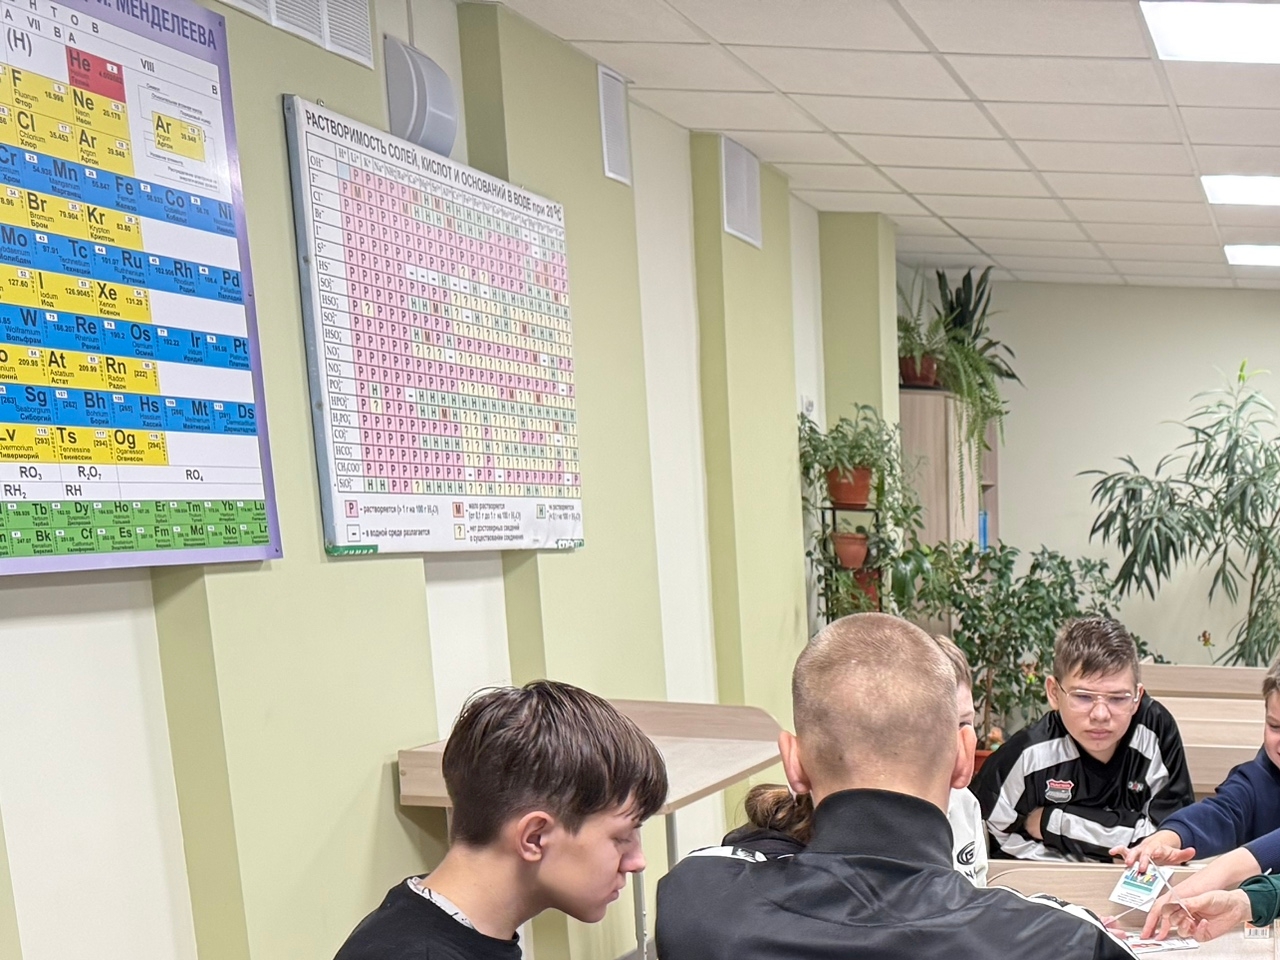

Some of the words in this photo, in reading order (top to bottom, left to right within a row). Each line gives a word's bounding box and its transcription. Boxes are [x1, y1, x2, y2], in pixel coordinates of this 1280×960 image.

[27, 16, 41, 31] VII
[50, 6, 58, 18] Т
[70, 14, 79, 26] О
[91, 22, 99, 34] В
[116, 0, 217, 50] МЕНДЕЛЕЕВА
[7, 27, 32, 57] (H)
[69, 49, 91, 72] He
[140, 58, 155, 73] VIII
[73, 88, 95, 111] Ne
[17, 110, 36, 132] Cl
[156, 115, 172, 134] Ar
[79, 129, 97, 149] Ar
[53, 159, 78, 181] Mn
[305, 109, 387, 155] РАСТВОРИМОСТЬ
[388, 143, 420, 170] СОЛЕЙ,
[420, 155, 452, 180] КИСЛОТ
[454, 168, 461, 184] И
[461, 171, 506, 201] ОСНОВАНИЙ
[507, 189, 513, 203] В
[513, 192, 531, 211] ВОДЕ
[532, 203, 545, 217] при
[115, 176, 134, 196] Fe
[27, 191, 47, 213] Br
[165, 189, 185, 209] Co
[86, 205, 105, 226] Kr
[219, 202, 233, 221] Ni
[1, 225, 28, 247] Mo
[68, 239, 88, 259] Tc
[121, 250, 142, 270] Ru
[173, 260, 193, 280] Rh
[222, 270, 240, 288] Pd
[97, 281, 117, 301] Xe
[20, 308, 37, 327] W
[75, 315, 97, 335] Re
[130, 323, 151, 342] Os
[233, 338, 248, 354] Pt
[48, 350, 67, 369] At
[105, 356, 127, 375] Rn
[24, 386, 48, 407] Sg
[84, 392, 106, 409] Bh
[140, 396, 160, 413] Hs
[192, 400, 209, 417] Mt
[238, 404, 255, 419] Ds
[56, 427, 77, 444] Ts
[114, 429, 136, 449] Og
[65, 484, 82, 496] RH
[32, 503, 47, 516] Tb
[74, 502, 89, 516] Dy
[114, 501, 129, 513] Ho
[155, 501, 166, 512] Er
[186, 501, 201, 512] Tm
[222, 500, 234, 511] Yb
[254, 500, 265, 511] Lu
[349, 503, 354, 514] Р
[36, 530, 52, 542] Bk
[81, 528, 93, 540] Cf
[119, 527, 133, 538] Es
[154, 526, 170, 537] Fm
[190, 525, 204, 536] Md
[224, 524, 237, 535] No
